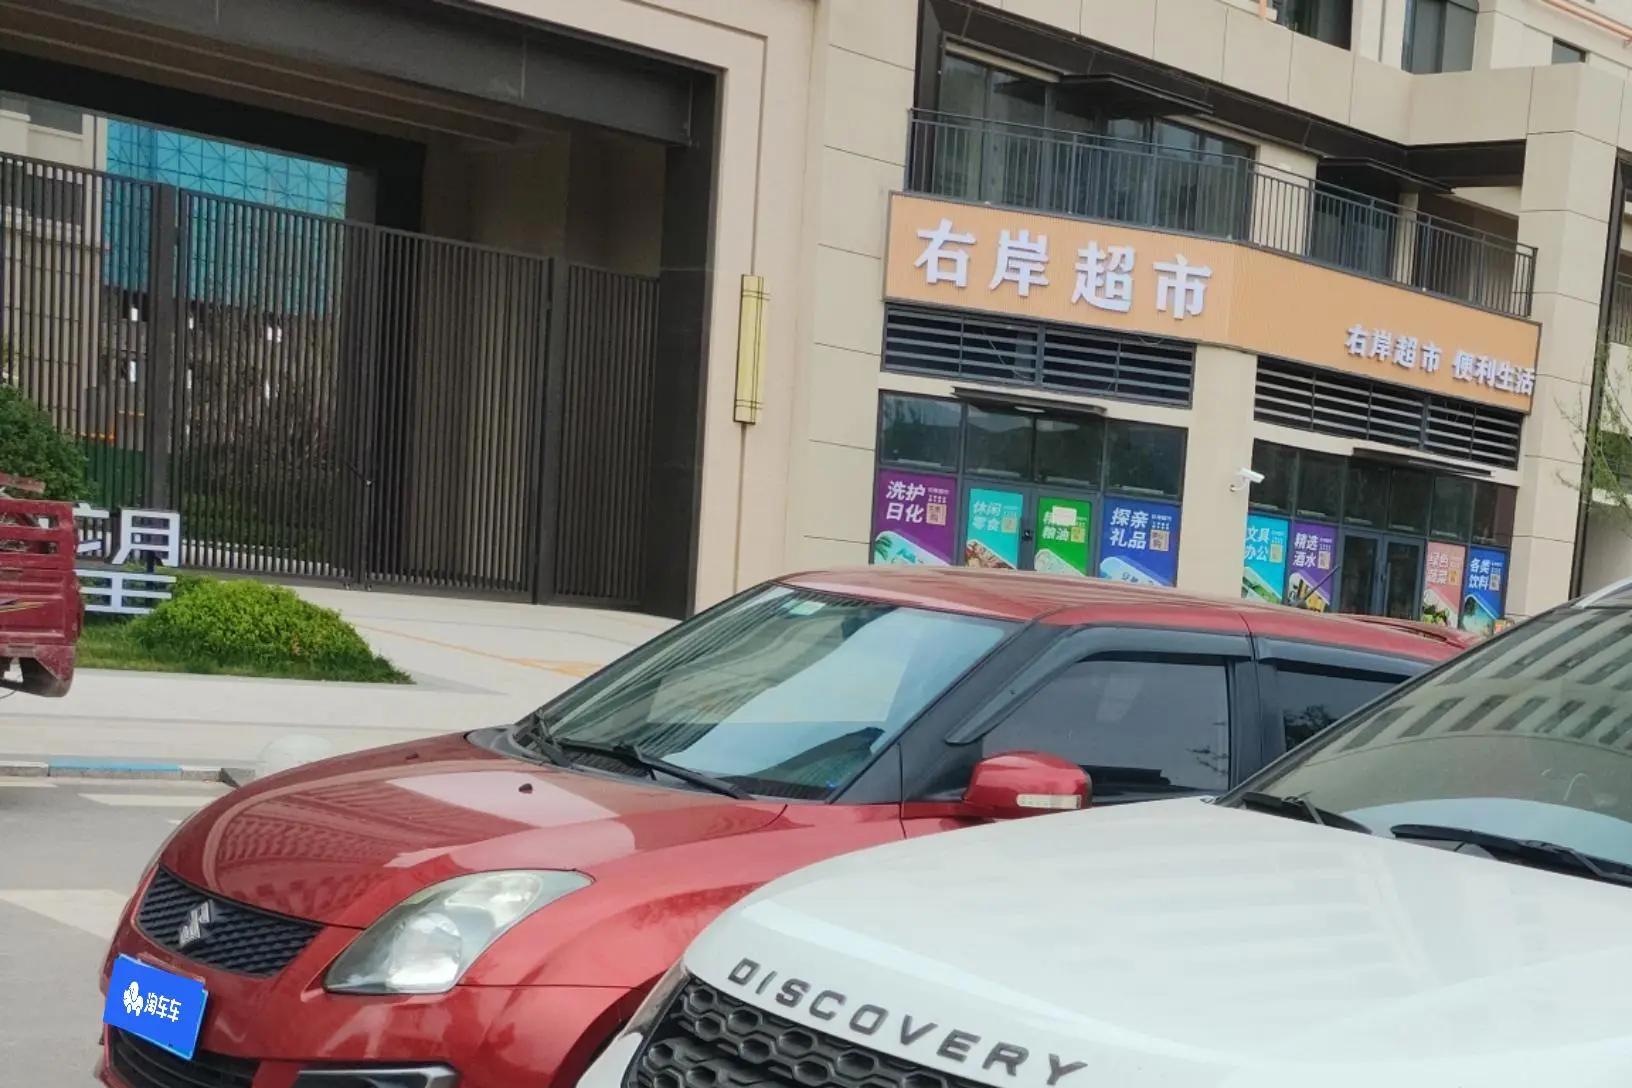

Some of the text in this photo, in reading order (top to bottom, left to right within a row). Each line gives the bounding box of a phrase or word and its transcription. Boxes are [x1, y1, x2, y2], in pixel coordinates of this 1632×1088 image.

[914, 217, 1213, 320] 右岸超市
[1345, 324, 1536, 396] 右岸超市 便利生活
[886, 480, 926, 502] 洗护
[886, 502, 925, 524] 日化
[973, 501, 1002, 517] 休闲
[1110, 507, 1149, 529] 探亲
[1110, 528, 1147, 550] 礼品
[1246, 525, 1270, 544] 文具
[1294, 533, 1318, 551] 精选
[1244, 543, 1269, 562] 办公
[1292, 551, 1317, 568] 酒水
[1470, 557, 1491, 574] 各类
[1468, 574, 1490, 591] 饮料
[728, 957, 1088, 1087] DISCOVERY
